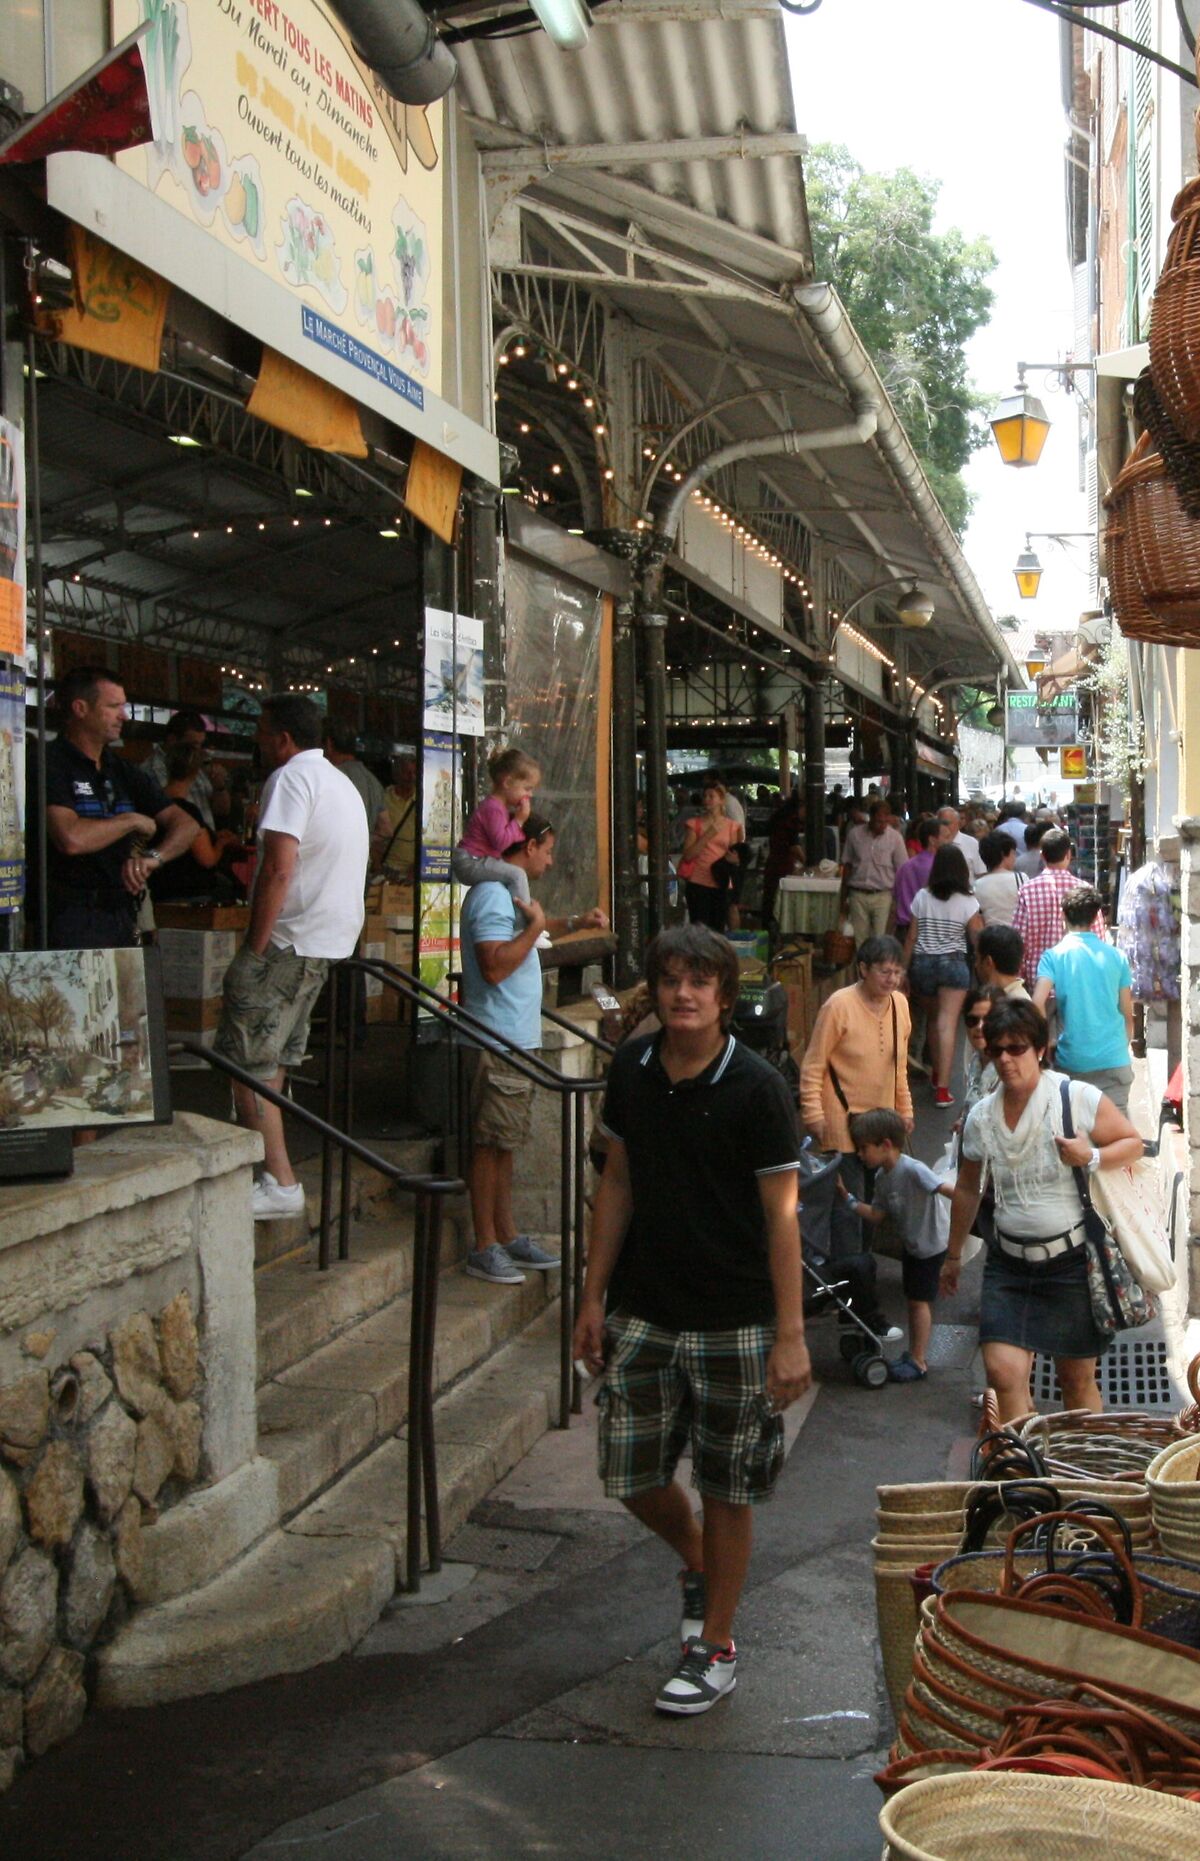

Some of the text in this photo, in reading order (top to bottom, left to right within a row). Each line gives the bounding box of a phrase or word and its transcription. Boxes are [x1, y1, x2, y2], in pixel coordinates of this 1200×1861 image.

[218, 0, 242, 27] Du
[248, 16, 288, 71] Mardi
[290, 67, 311, 96] au
[316, 88, 378, 162] Dimanche
[282, 12, 311, 65] TOUS
[314, 47, 332, 87] LES
[335, 69, 373, 128] MATINS
[238, 94, 372, 234] Ouvert tous les matins
